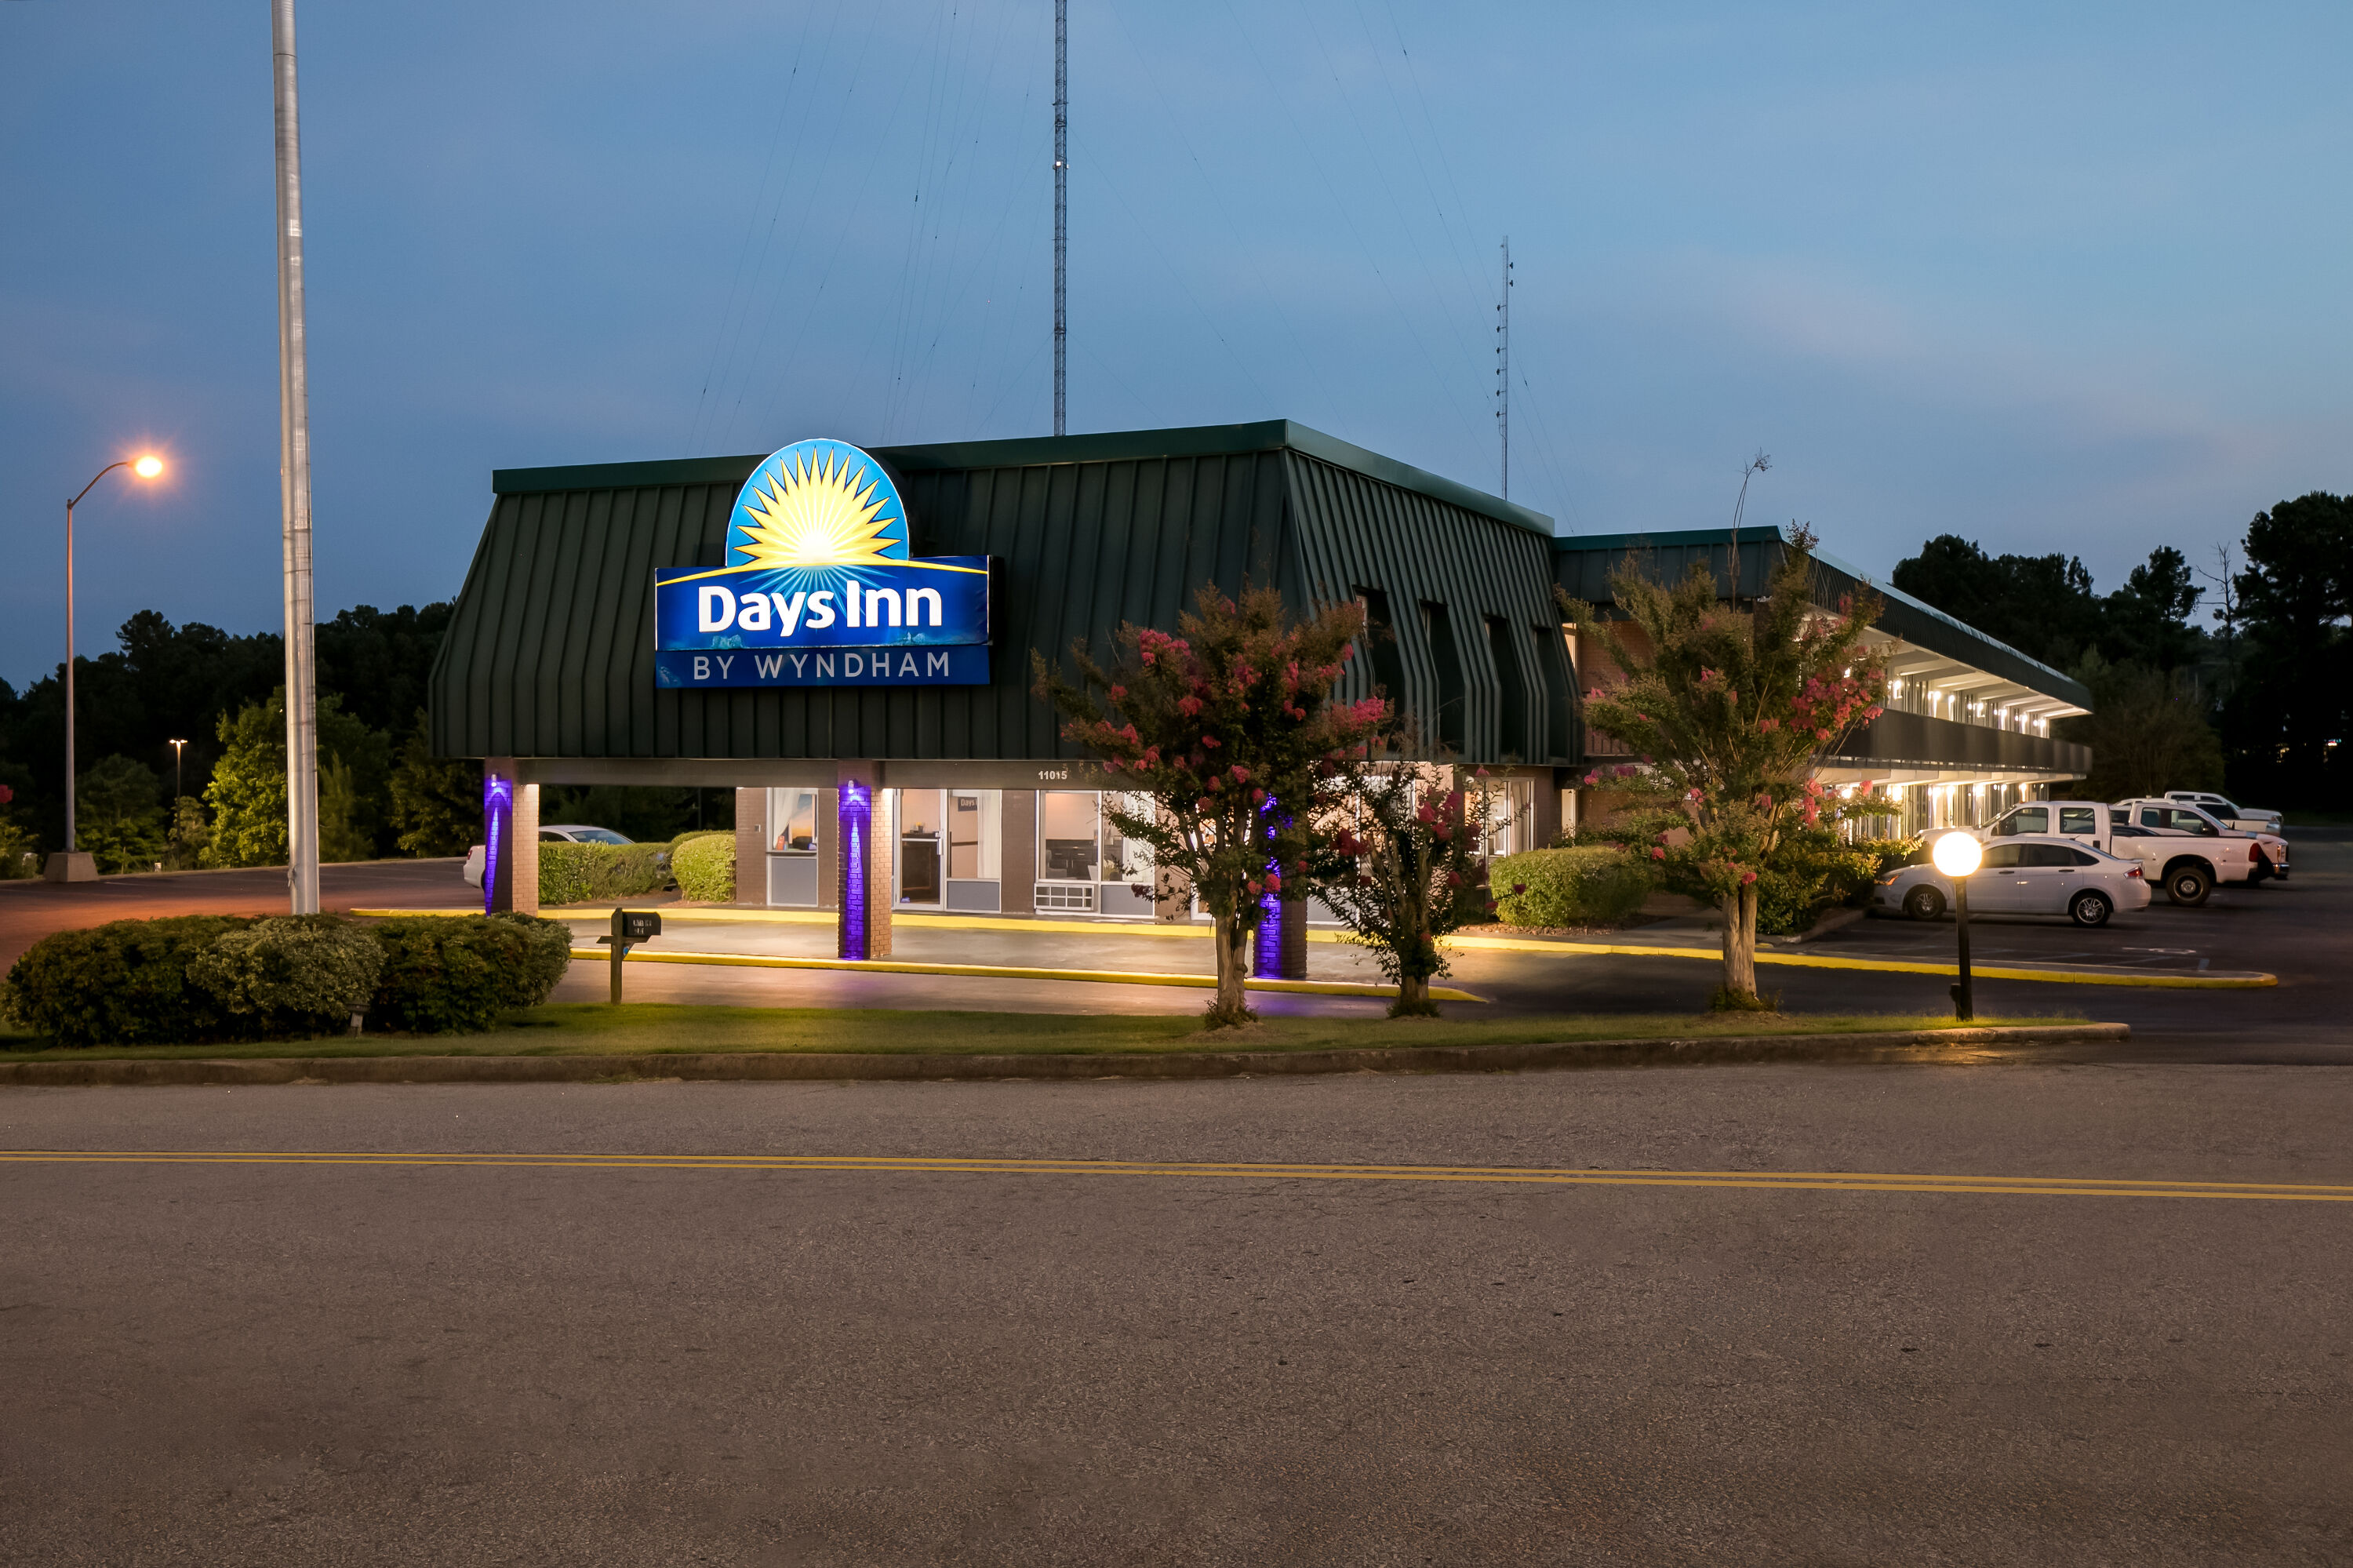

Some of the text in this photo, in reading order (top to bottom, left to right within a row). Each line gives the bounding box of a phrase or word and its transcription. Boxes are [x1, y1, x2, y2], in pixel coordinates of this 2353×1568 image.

[698, 580, 943, 637] Days Inn
[693, 652, 950, 680] BY WYNDHAM
[1038, 770, 1067, 780] 11015
[961, 799, 975, 807] Days
